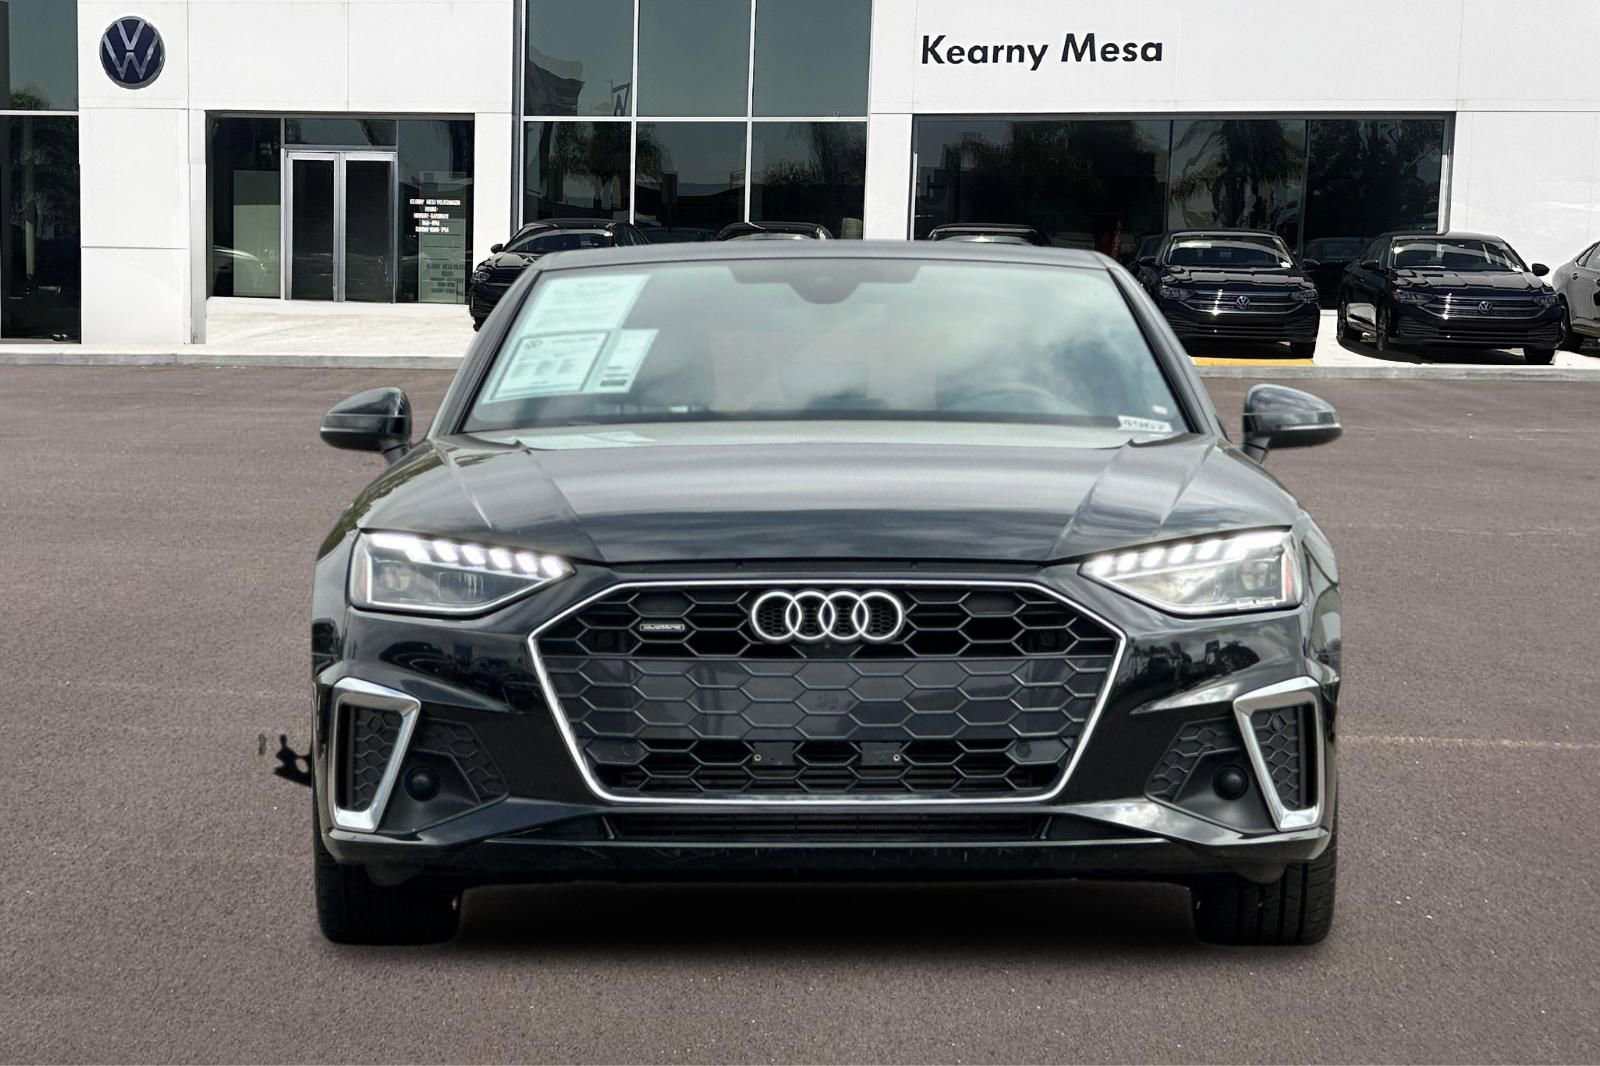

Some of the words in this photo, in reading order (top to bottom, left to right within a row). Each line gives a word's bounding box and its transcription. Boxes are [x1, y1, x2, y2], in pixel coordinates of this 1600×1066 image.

[101, 18, 162, 82] VW
[921, 35, 1049, 71] Kearny
[1061, 33, 1163, 62] Mesa
